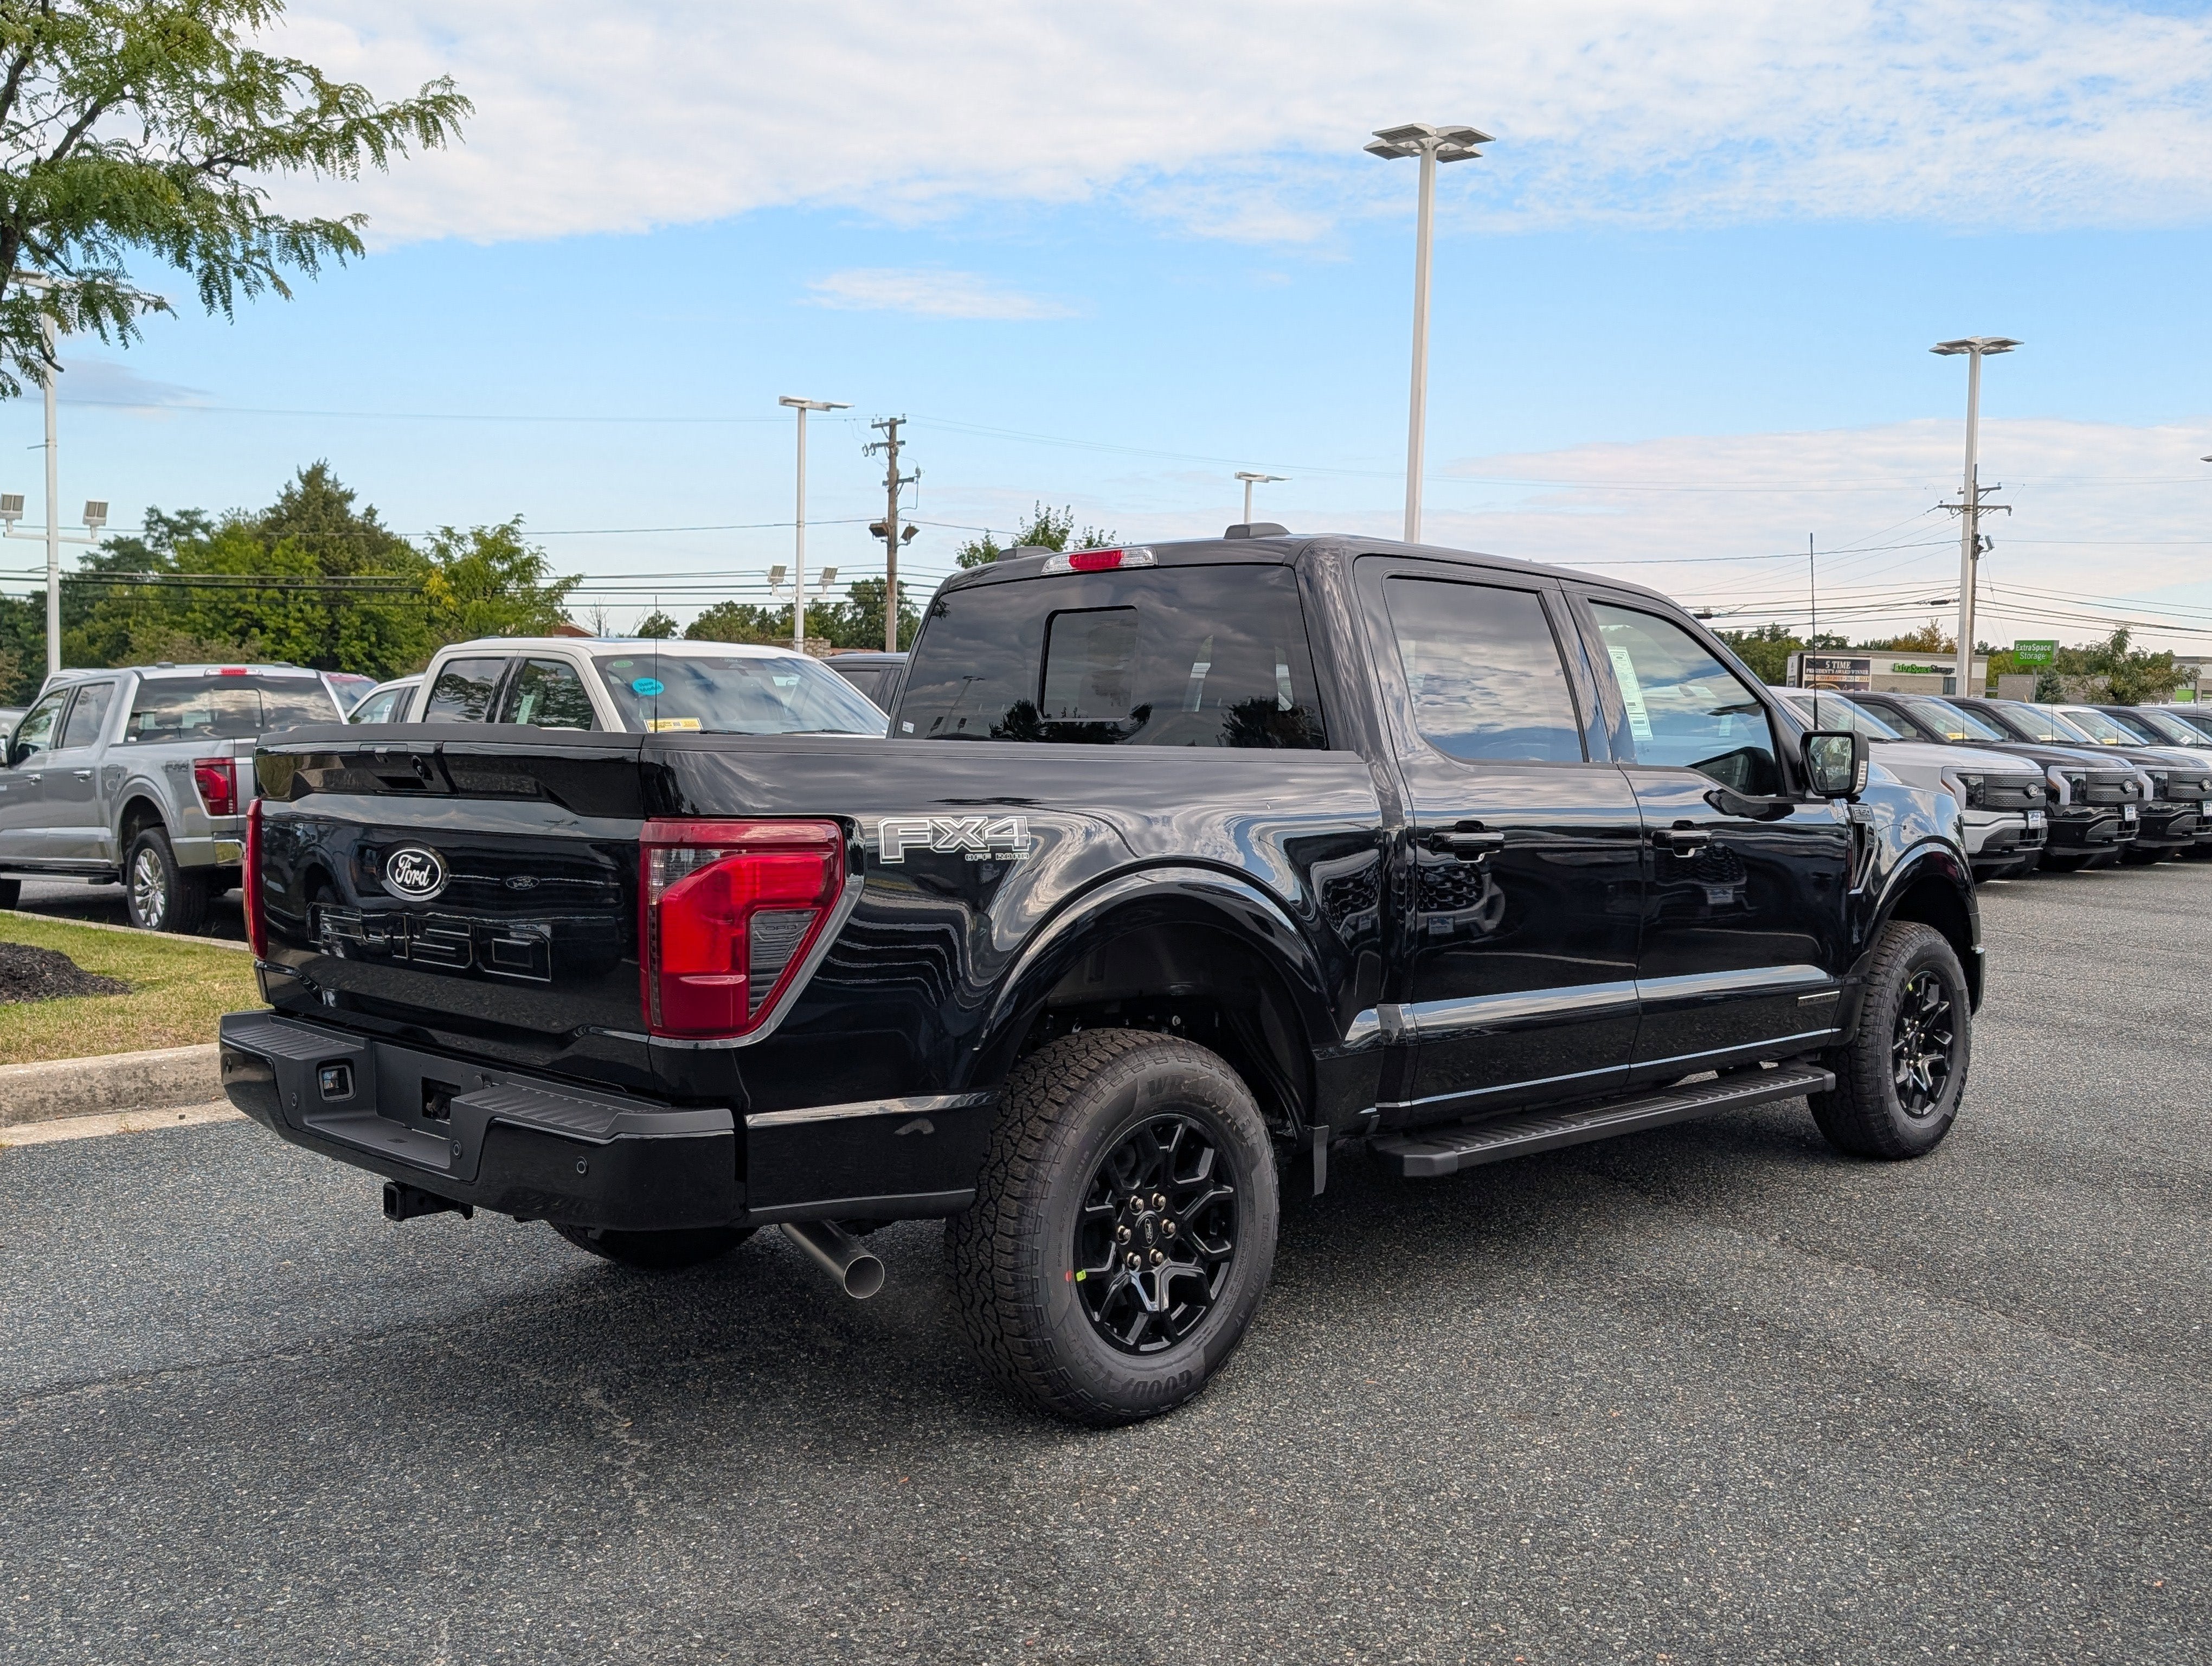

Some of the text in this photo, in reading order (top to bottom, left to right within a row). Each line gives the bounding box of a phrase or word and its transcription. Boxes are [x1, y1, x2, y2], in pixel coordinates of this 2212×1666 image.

[2016, 643, 2052, 652] ExtraSpace
[2020, 651, 2046, 661] Storage
[1825, 661, 1851, 669] 5 TIME
[878, 816, 1031, 864] FX4
[965, 852, 1030, 861] OFF ROAD
[395, 854, 430, 887] Ford
[306, 902, 551, 982] F-150
